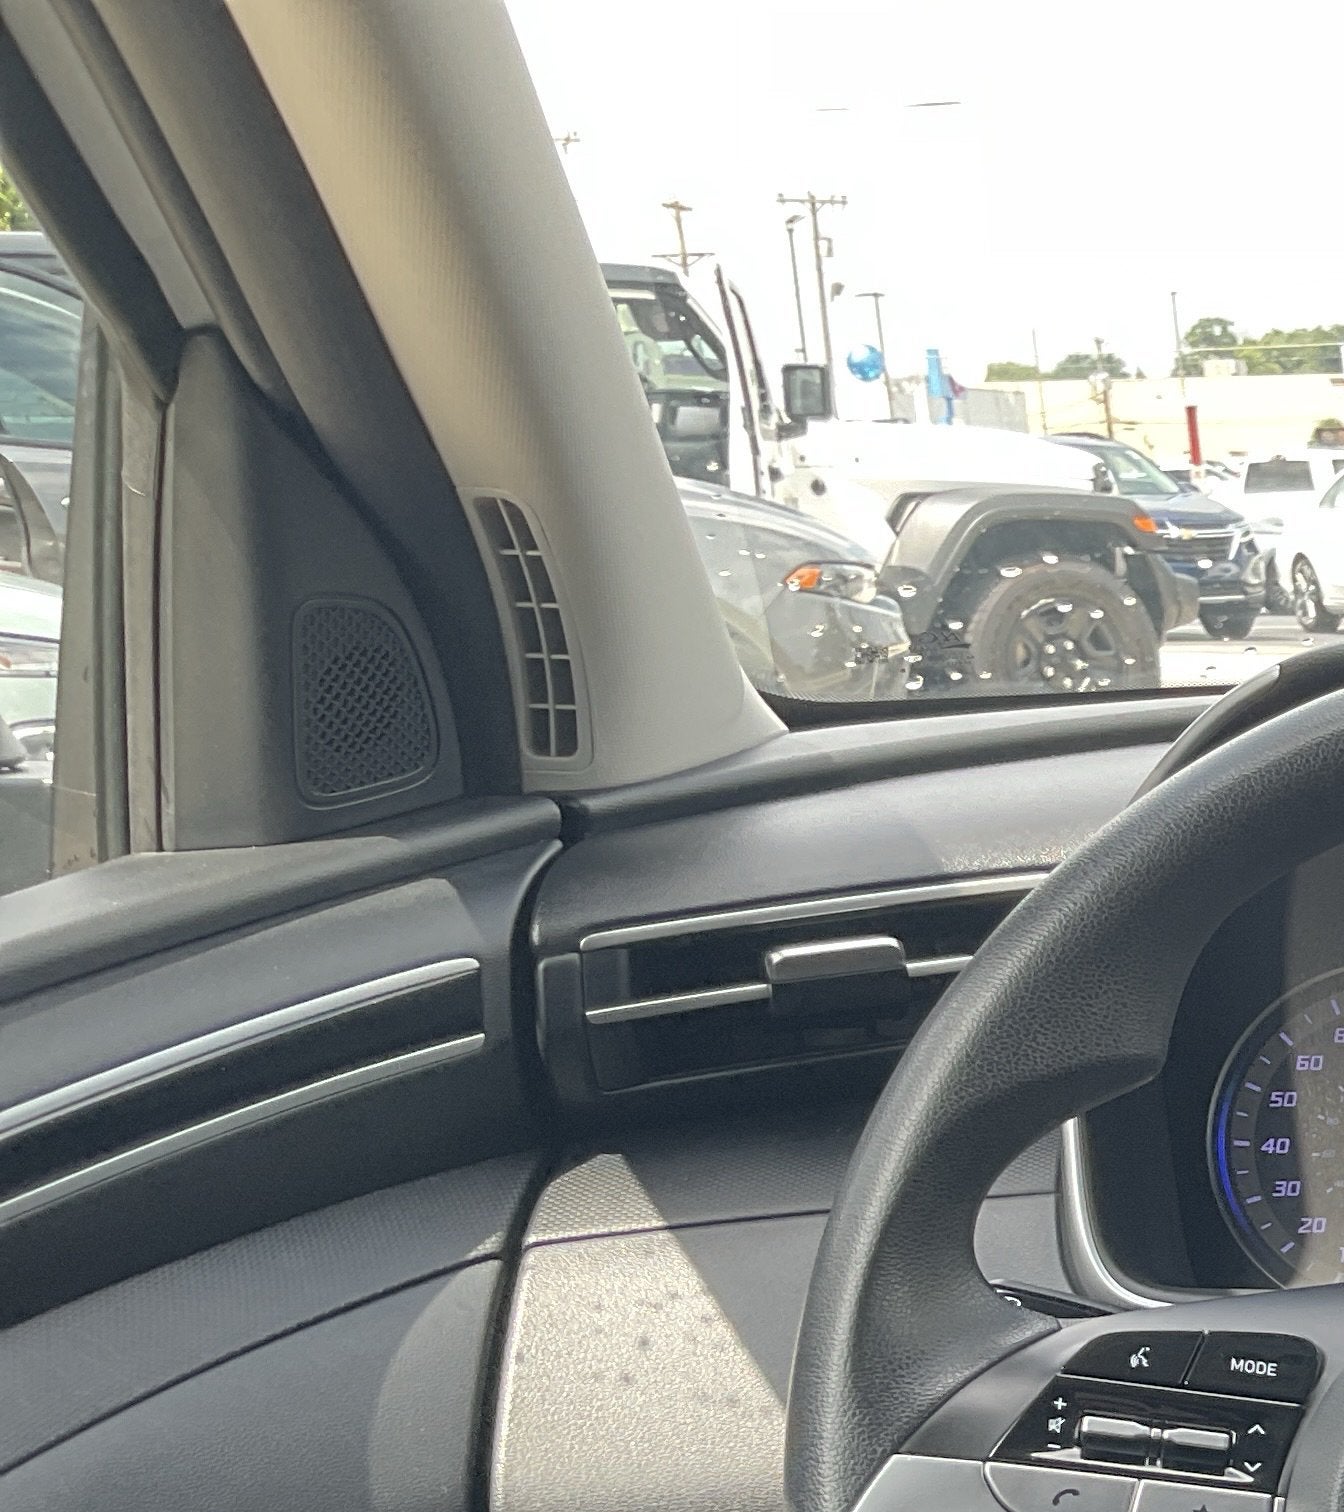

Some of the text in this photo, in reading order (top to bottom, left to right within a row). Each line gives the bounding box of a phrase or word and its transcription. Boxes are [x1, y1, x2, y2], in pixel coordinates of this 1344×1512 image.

[1295, 1054, 1324, 1071] 60
[1268, 1091, 1297, 1108] 50
[1260, 1137, 1291, 1155] 40
[1271, 1180, 1302, 1198] 30
[1297, 1217, 1328, 1235] 20
[1229, 1356, 1279, 1378] MODE
